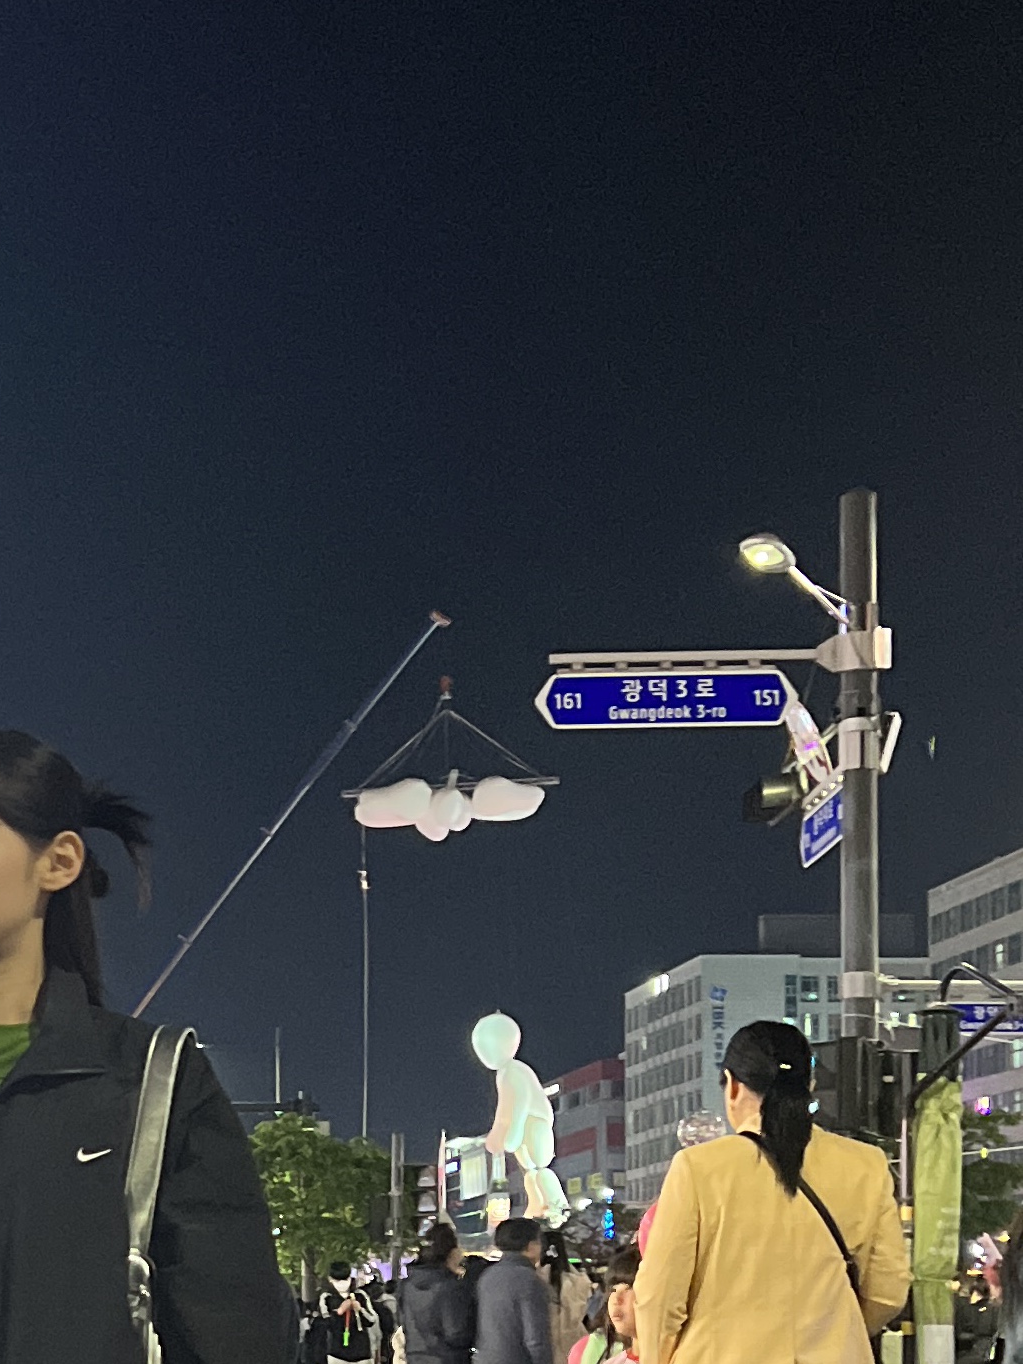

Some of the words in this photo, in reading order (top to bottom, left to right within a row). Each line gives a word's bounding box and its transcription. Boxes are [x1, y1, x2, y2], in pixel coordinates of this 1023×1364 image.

[554, 692, 582, 709] 161
[753, 689, 780, 706] 151
[607, 705, 691, 721] Gwangdeok
[696, 705, 727, 719] 3-ro
